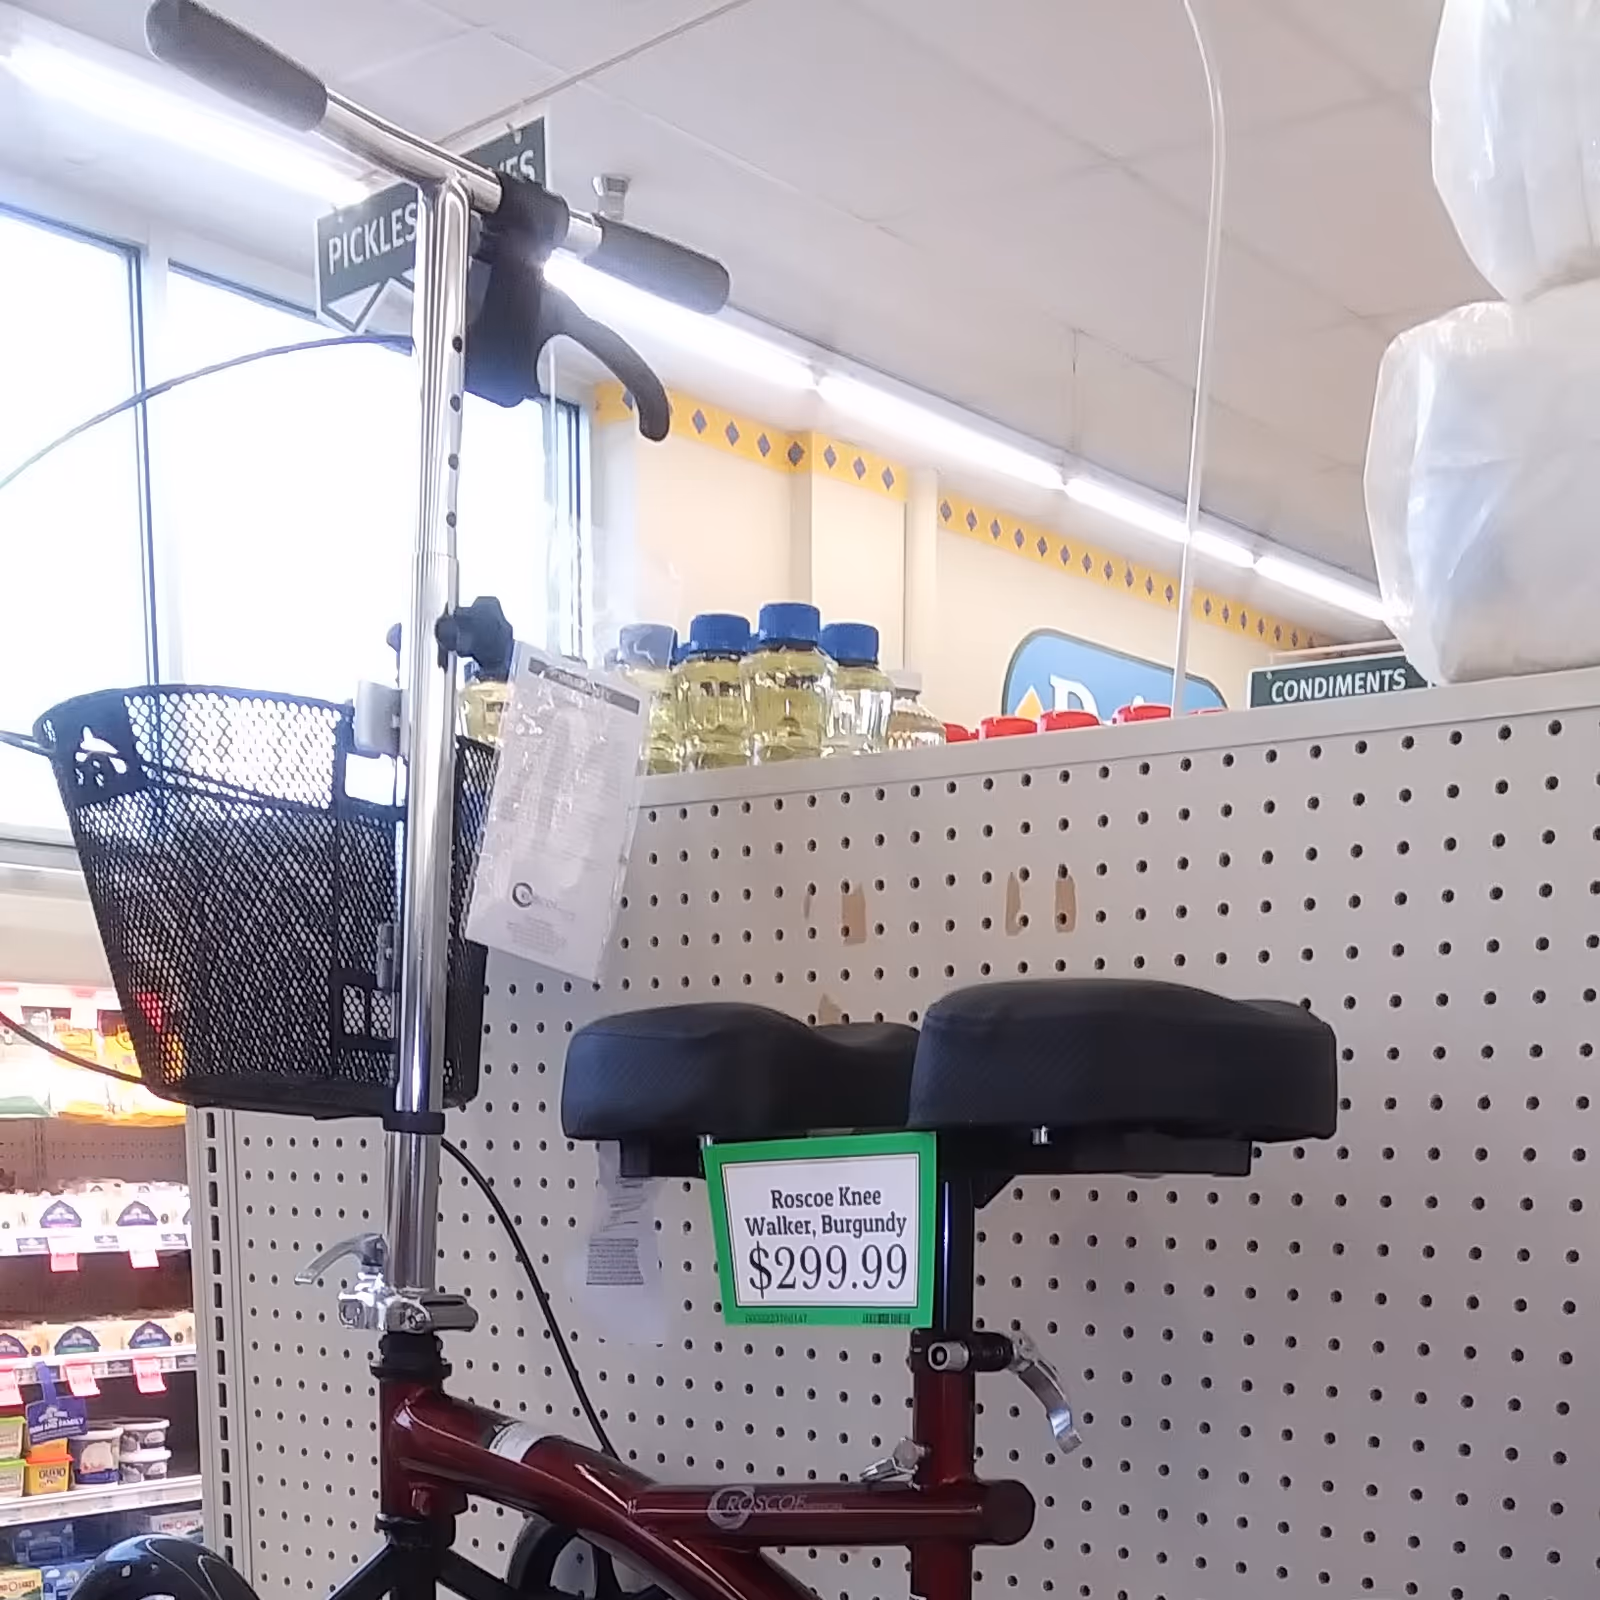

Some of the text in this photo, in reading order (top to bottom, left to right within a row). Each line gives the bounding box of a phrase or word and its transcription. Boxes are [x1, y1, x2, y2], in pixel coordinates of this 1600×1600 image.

[328, 202, 417, 275] PICKLES
[1271, 668, 1407, 703] CONDIMENTS
[770, 1186, 882, 1210] Roscoe Knee
[744, 1210, 908, 1240] Walker, Burgundy
[749, 1240, 908, 1300] $299.99
